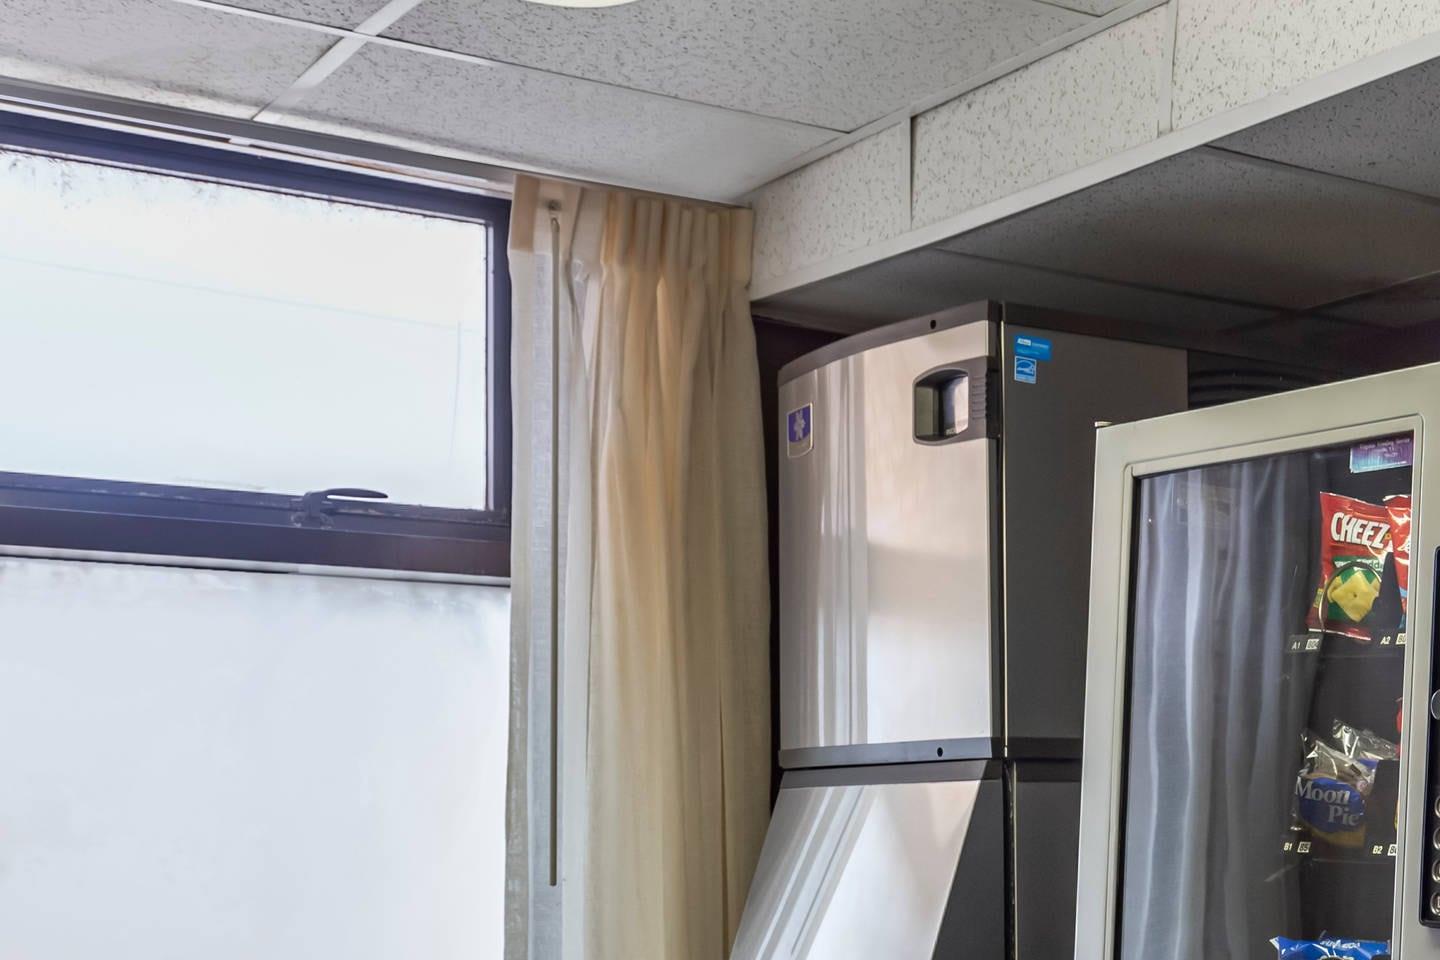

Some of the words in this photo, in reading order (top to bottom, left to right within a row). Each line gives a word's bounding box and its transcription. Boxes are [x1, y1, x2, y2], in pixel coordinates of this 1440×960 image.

[1330, 512, 1390, 549] CHEEZ
[1380, 636, 1390, 645] A2
[1295, 776, 1350, 805] Moon
[1328, 804, 1360, 826] Pie
